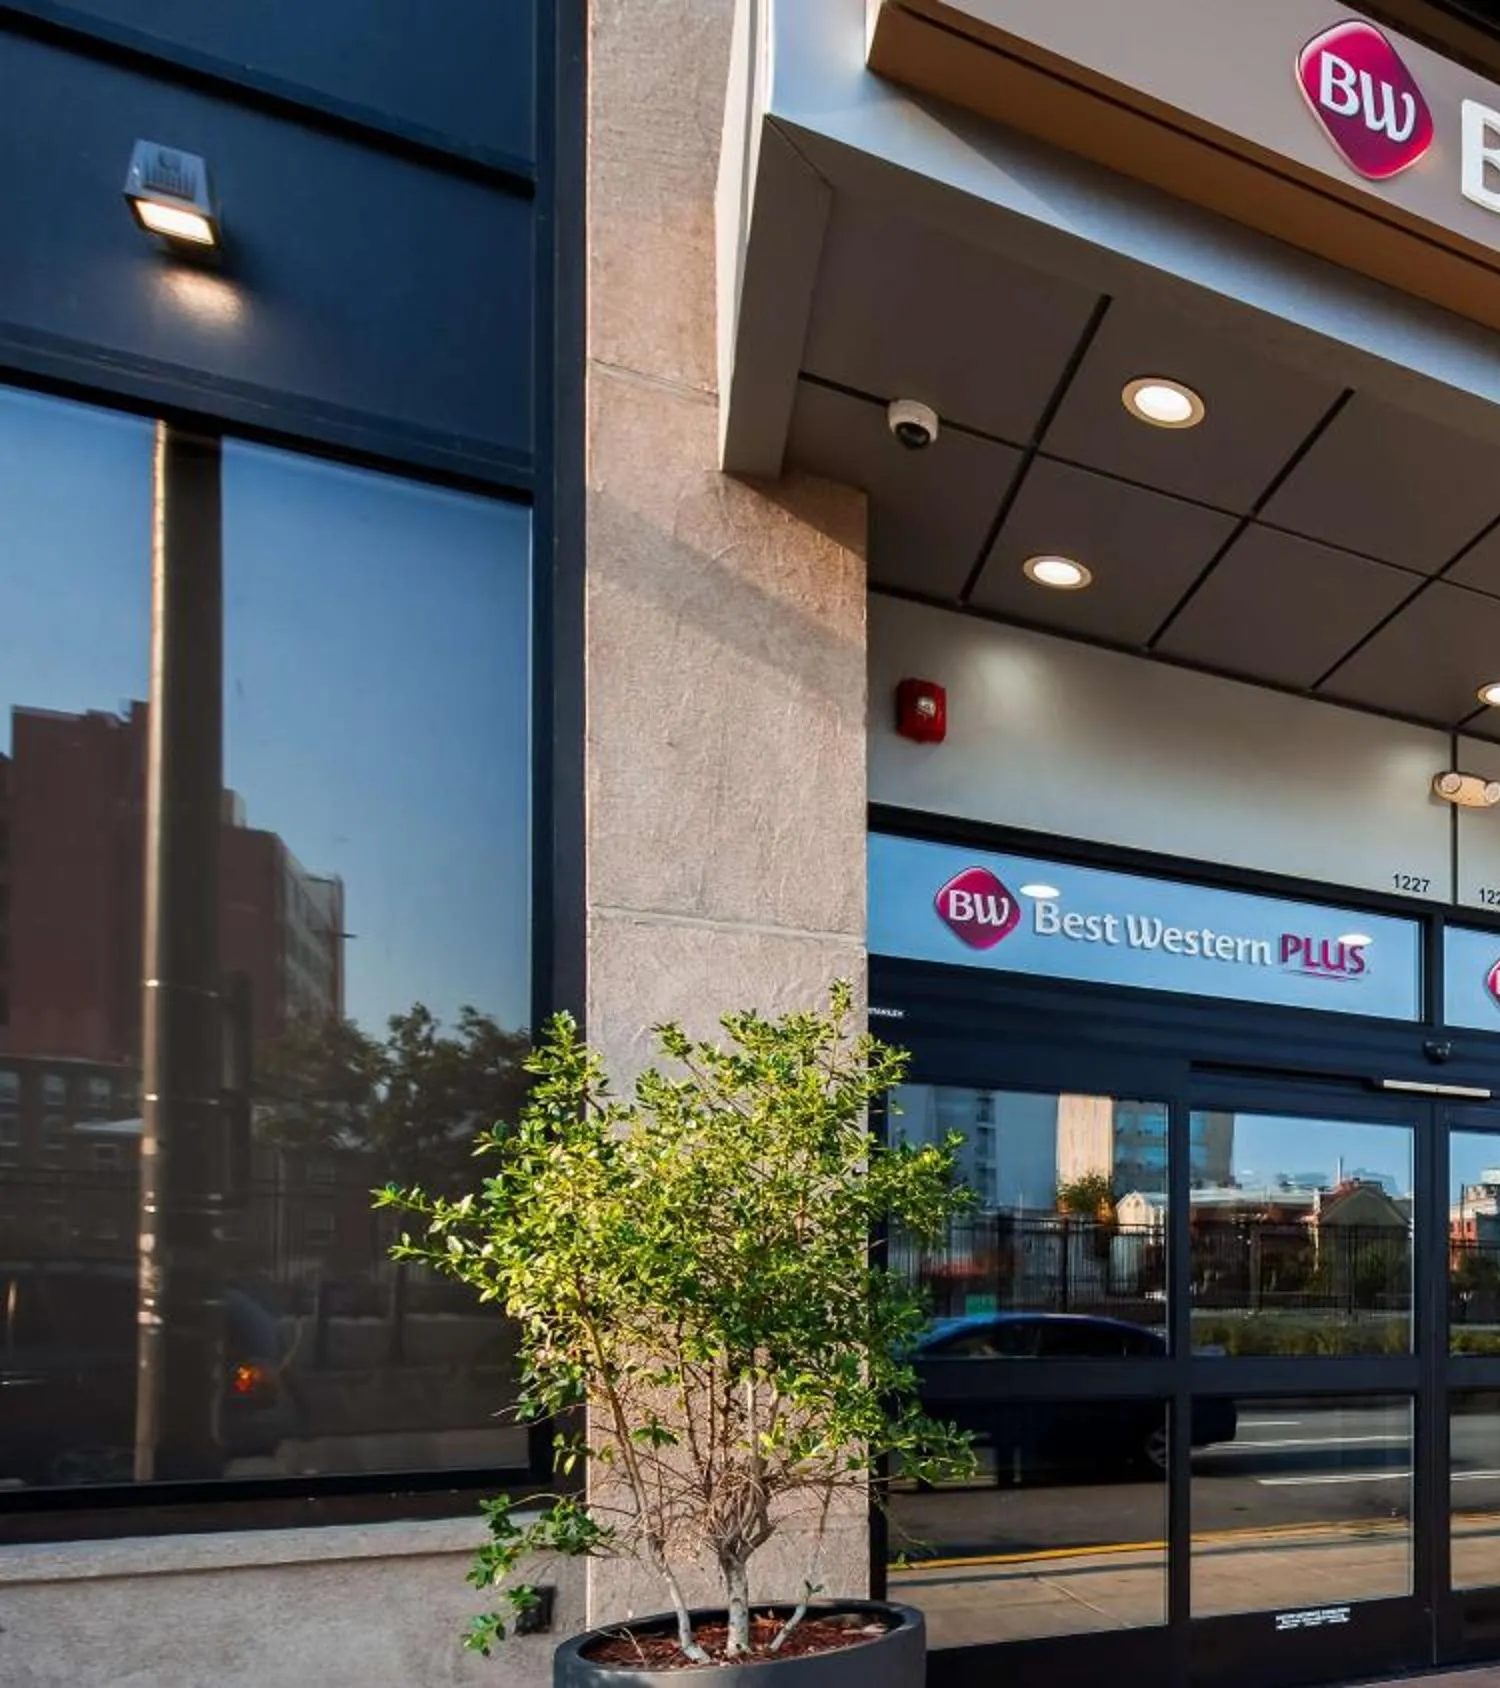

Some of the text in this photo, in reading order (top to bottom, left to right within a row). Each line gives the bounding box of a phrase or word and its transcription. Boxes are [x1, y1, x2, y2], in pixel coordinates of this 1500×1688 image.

[1320, 51, 1416, 142] BW
[950, 889, 1010, 926] BW
[1393, 873, 1430, 892] 1227
[1033, 899, 1367, 974] Best Western PLUS
